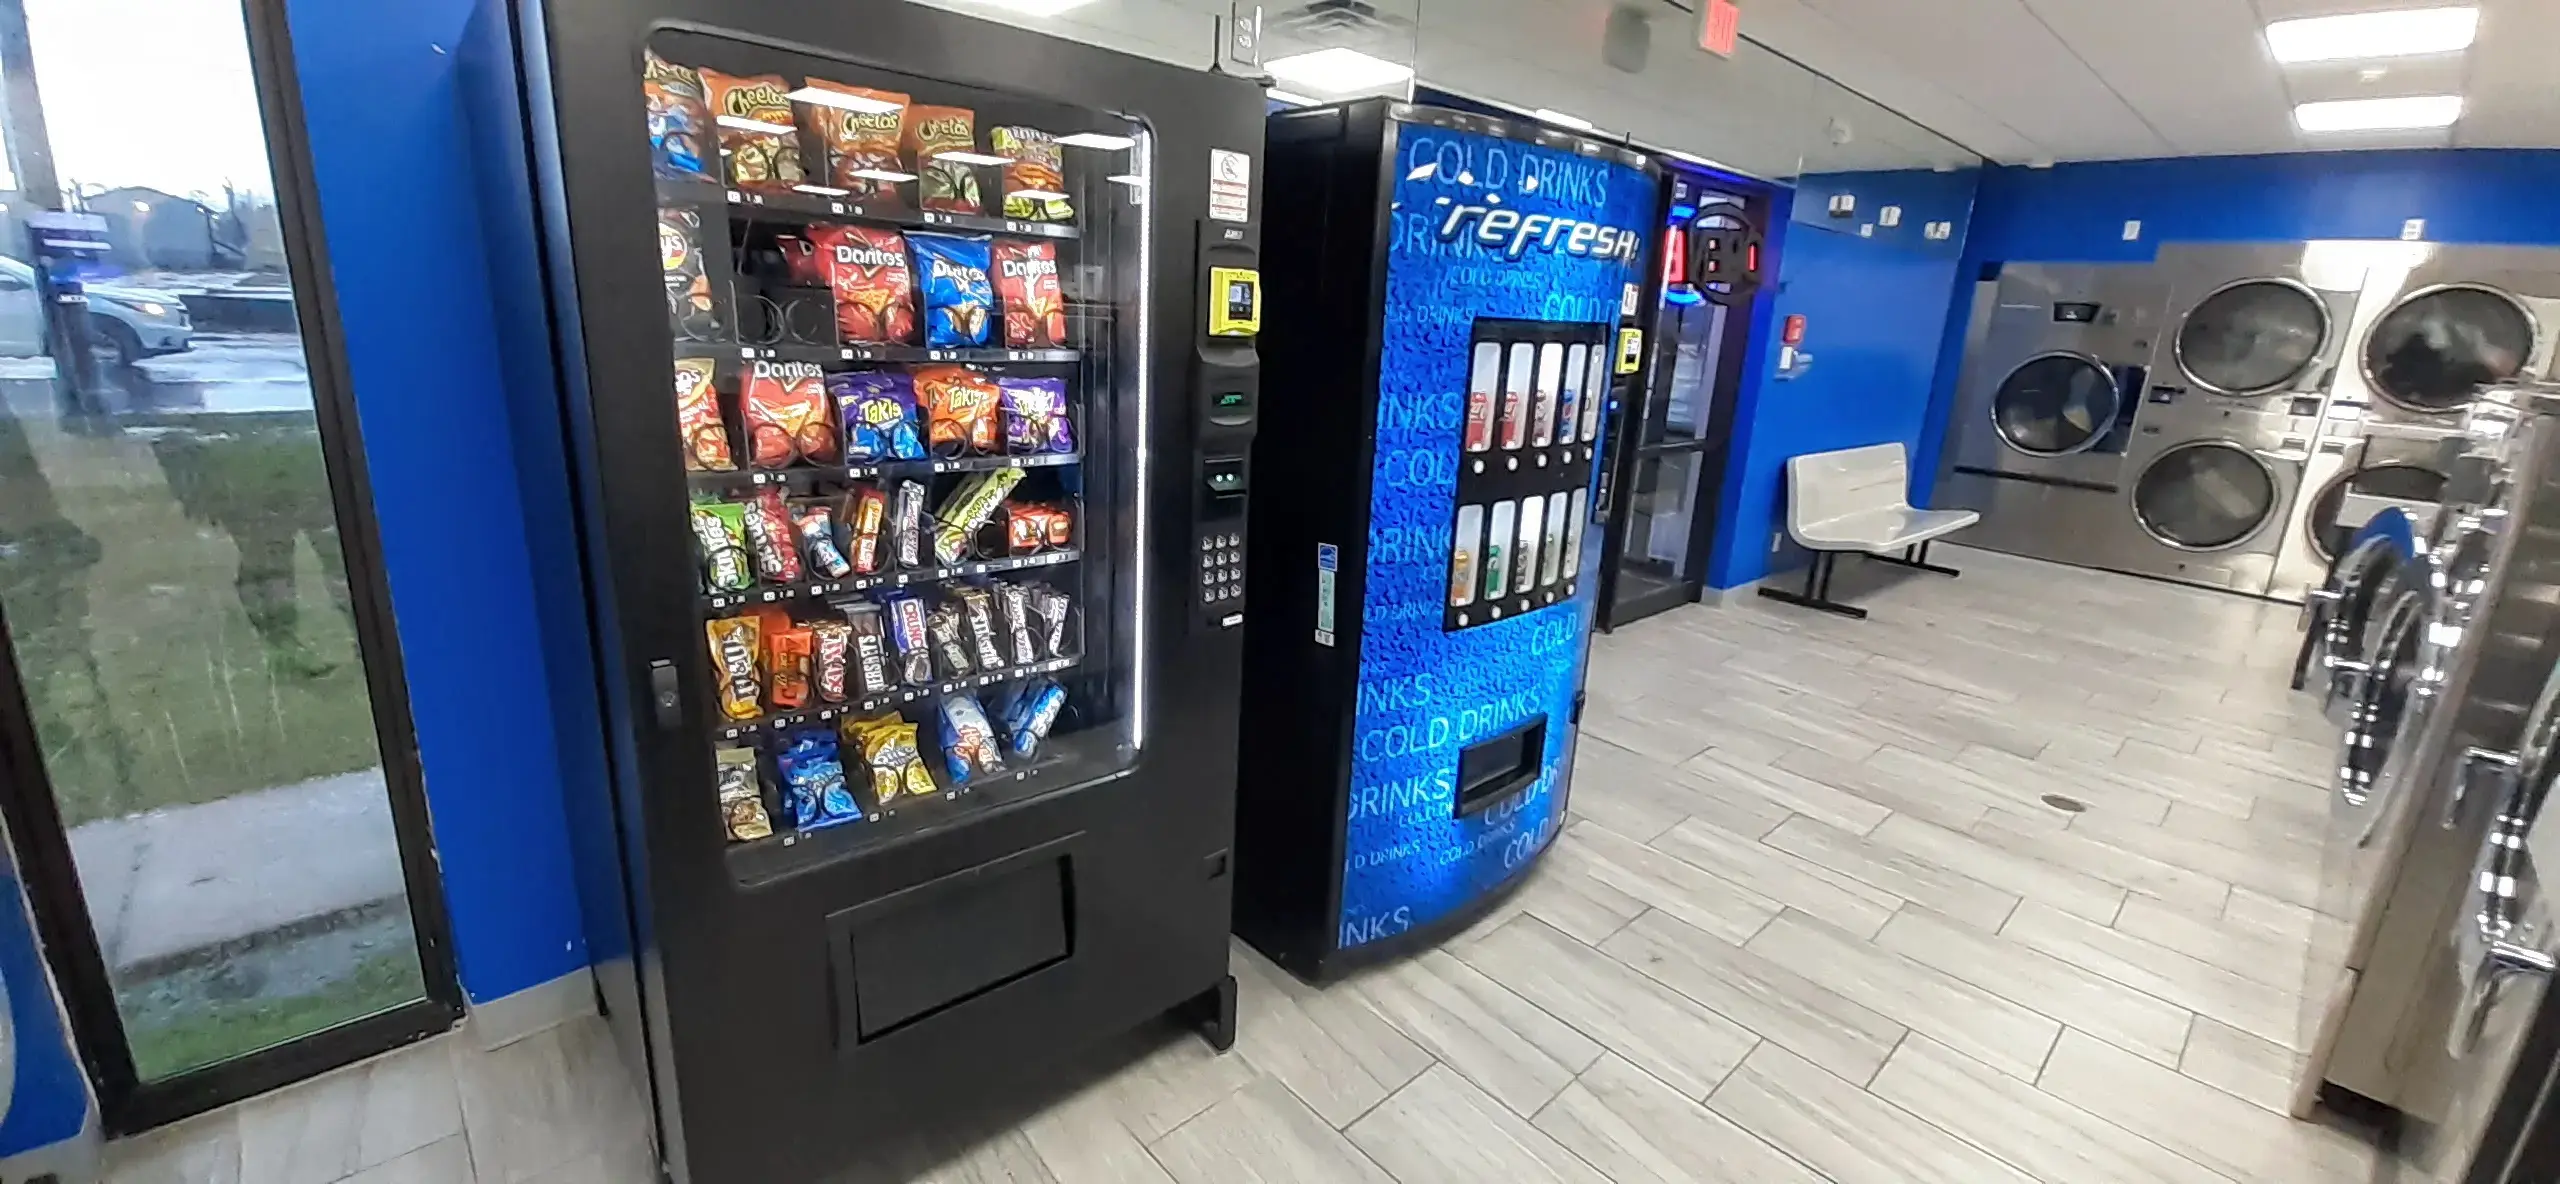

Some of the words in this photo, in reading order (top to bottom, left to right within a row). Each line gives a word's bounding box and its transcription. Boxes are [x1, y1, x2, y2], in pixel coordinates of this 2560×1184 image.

[1408, 137, 1508, 190] COLD
[1518, 152, 1609, 208] DRINKS
[836, 246, 905, 268] Doritos
[754, 361, 823, 379] Doritos
[860, 398, 903, 424] Takis
[901, 602, 929, 651] CRUNC
[1532, 612, 1577, 656] COLD
[1361, 716, 1449, 763] COLD
[1460, 684, 1541, 742] DRINKS
